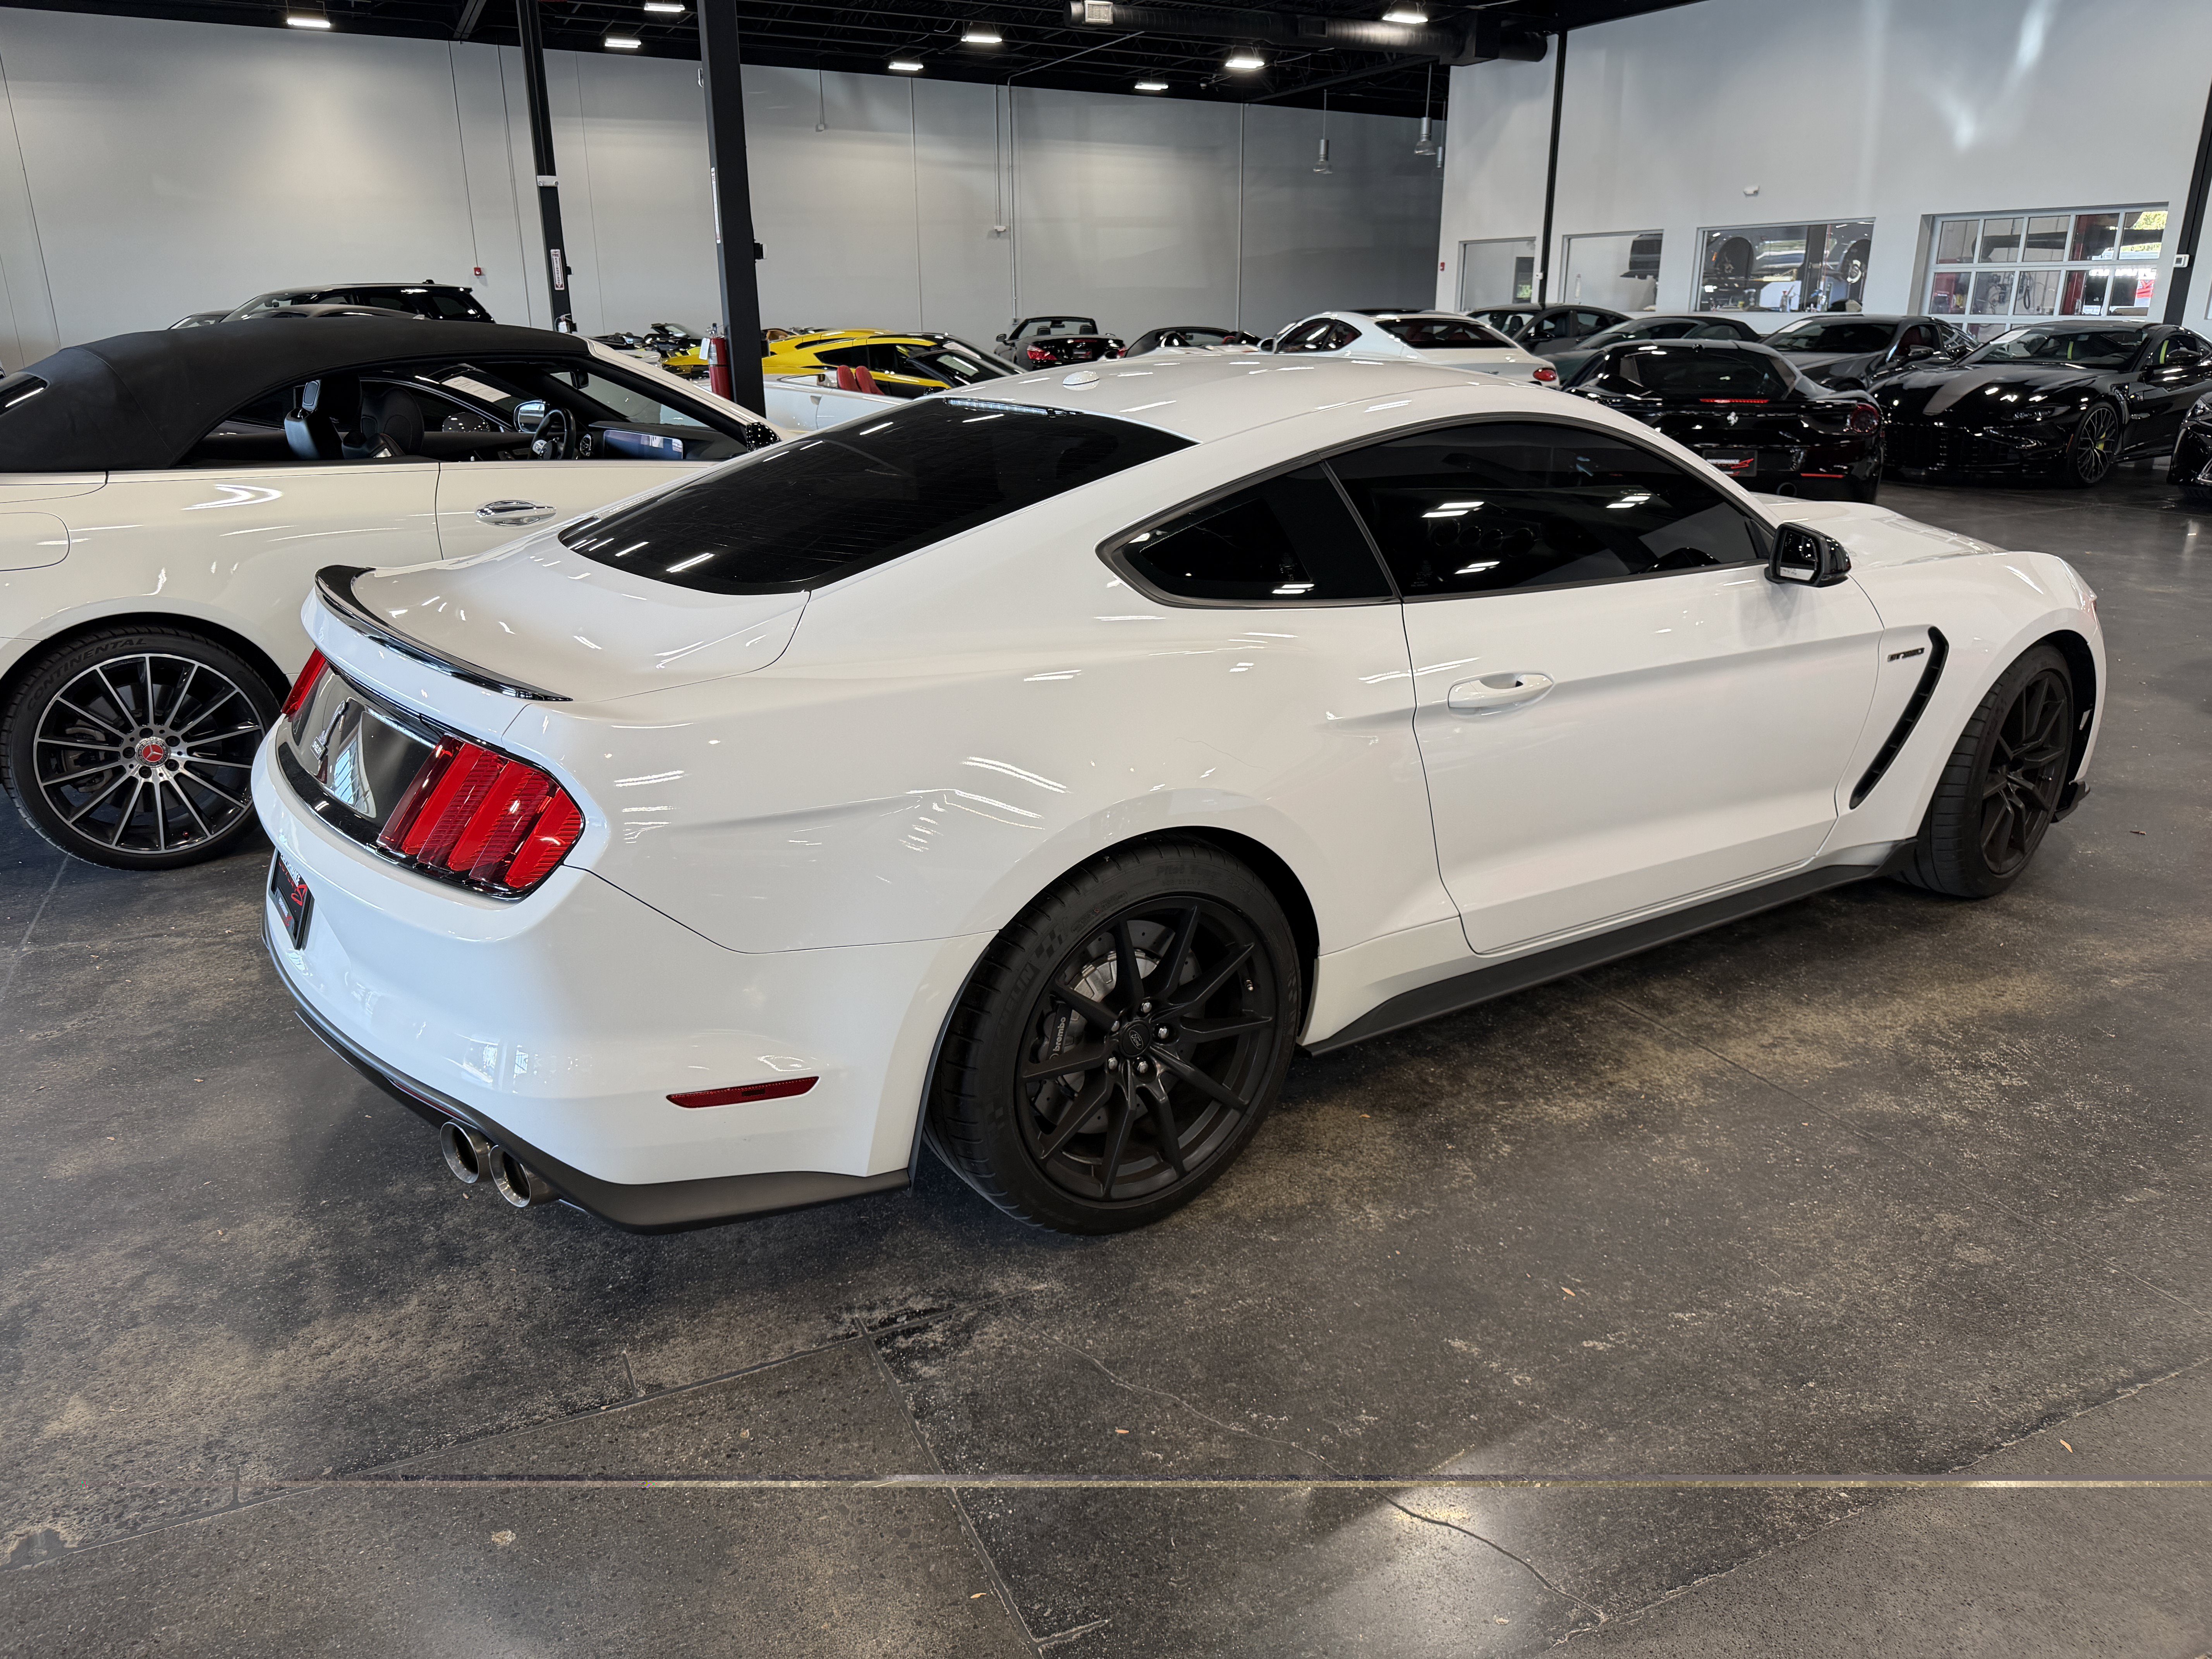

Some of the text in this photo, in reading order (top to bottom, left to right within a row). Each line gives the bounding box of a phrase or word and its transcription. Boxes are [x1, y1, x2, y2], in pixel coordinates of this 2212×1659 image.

[27, 638, 147, 711] CONTINENTAL
[1156, 865, 1184, 876] Pilot
[1053, 1017, 1066, 1051] brembo
[1131, 1034, 1142, 1047] Ford
